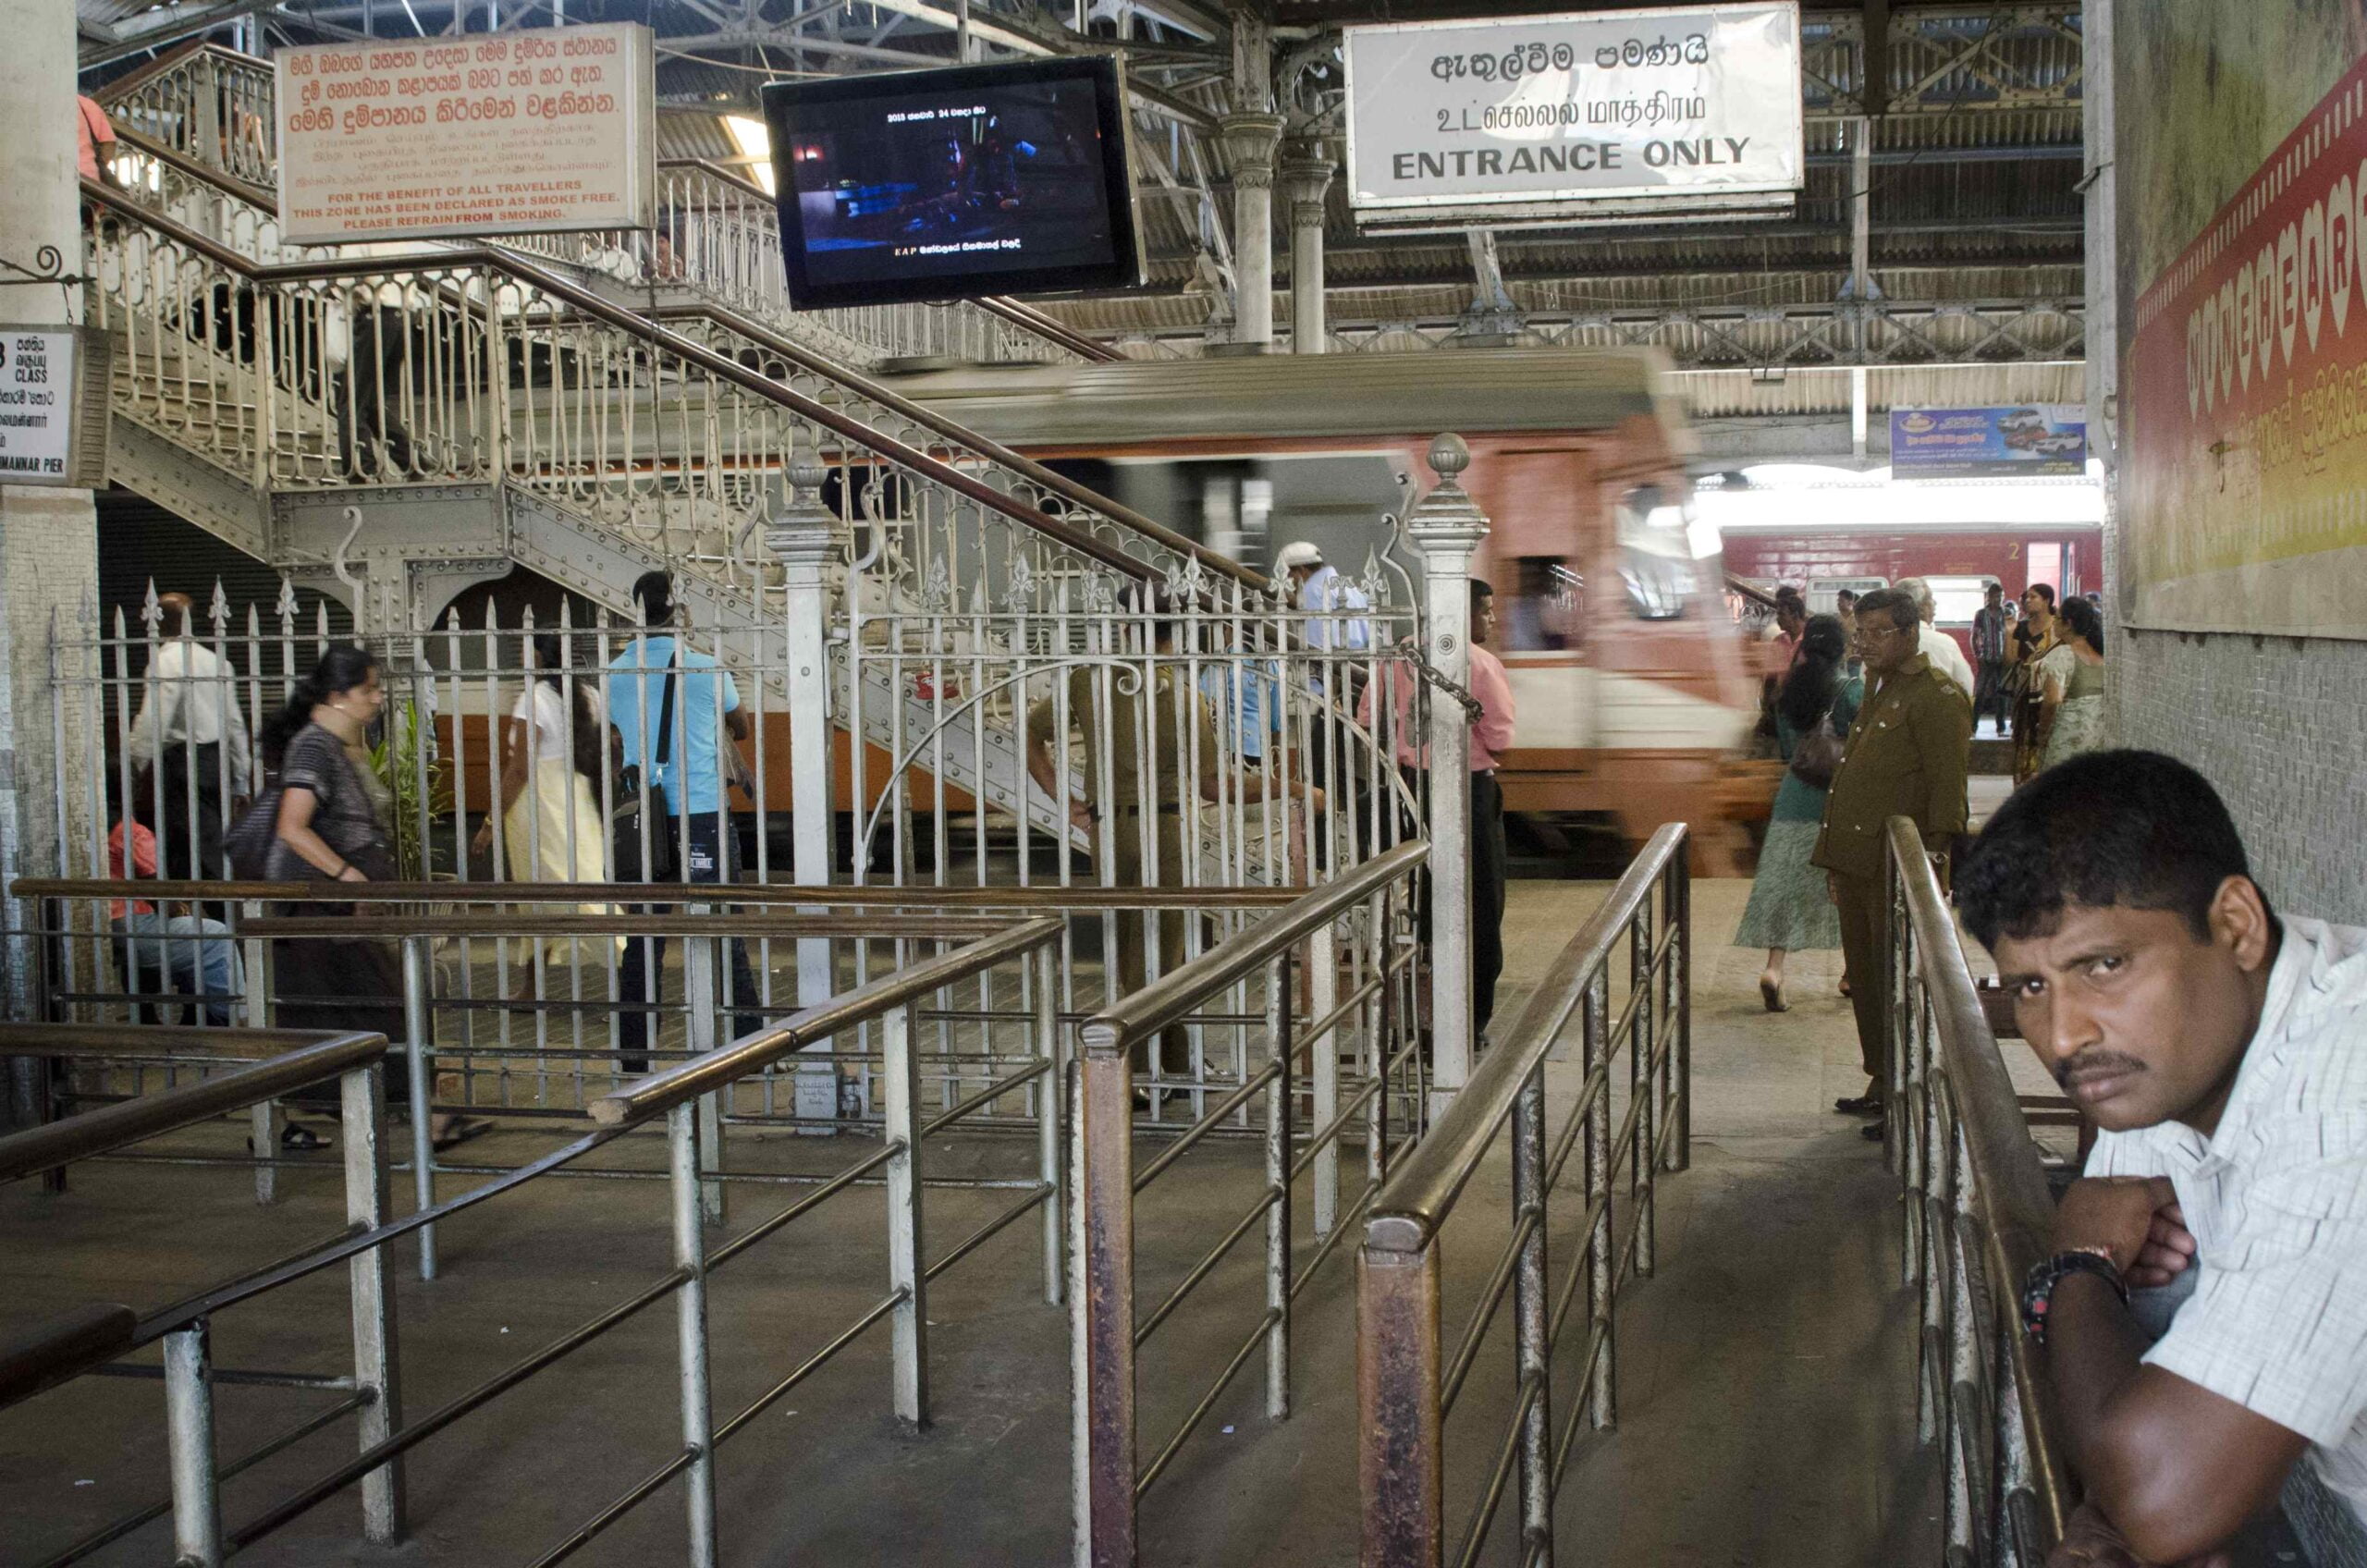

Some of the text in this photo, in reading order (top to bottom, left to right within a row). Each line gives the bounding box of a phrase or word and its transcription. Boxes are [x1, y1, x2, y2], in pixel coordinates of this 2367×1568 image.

[476, 41, 507, 62] මෙම
[1431, 33, 1709, 82] ඇතුල්වීම පමණයි
[468, 67, 500, 89] බවට
[540, 65, 563, 85] කර
[289, 105, 334, 132] මෙහි
[344, 104, 426, 134] දුම්පානය
[938, 109, 949, 118] 24
[1437, 87, 1706, 132] உட்செல்லல் மாத்திரம்
[1393, 137, 1750, 180] ENTRANCE ONLY
[328, 180, 583, 204] FOR THE BENEFIT OF ALL TRAVELLERS
[293, 192, 620, 219] THIS ZONE HAS BEEN DECLARED AS SMOKE FREE.
[344, 209, 566, 229] PLEASE REFRAIN FROM SMOKING.
[15, 368, 48, 384] CLASS
[43, 458, 64, 473] PIER
[2008, 541, 2020, 560] 2
